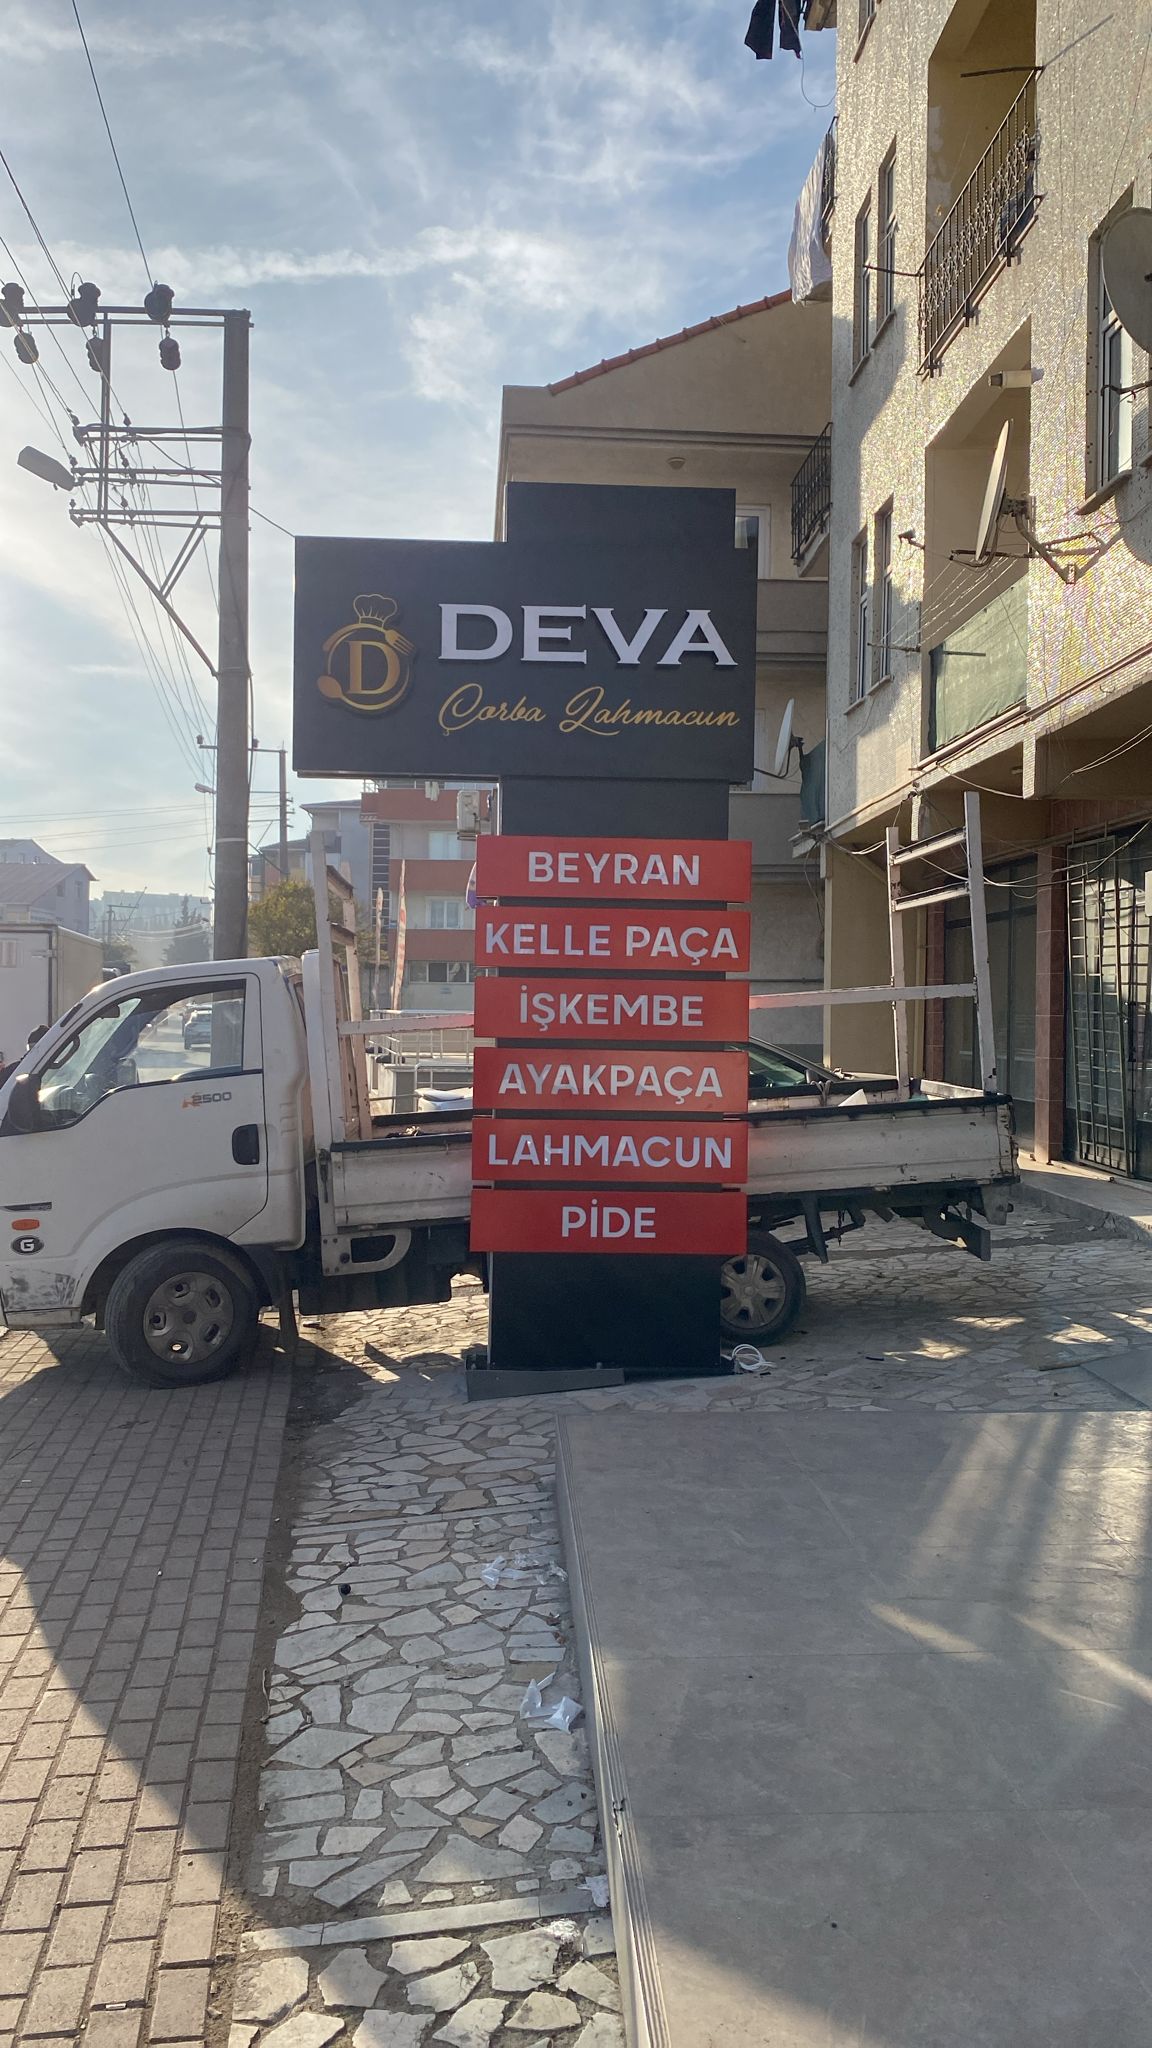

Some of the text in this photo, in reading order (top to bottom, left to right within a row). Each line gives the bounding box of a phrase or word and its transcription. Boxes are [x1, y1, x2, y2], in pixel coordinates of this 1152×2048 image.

[437, 603, 738, 666] DEVA
[347, 640, 400, 695] D
[438, 683, 741, 736] Çorba Lahmacun
[528, 851, 700, 886] BEYRAN
[486, 922, 739, 965] KELLE PAÇA
[520, 985, 704, 1031] İŞKEMBE
[498, 1063, 723, 1104] AYAKPAÇA
[488, 1134, 731, 1168] LAHMACUN
[561, 1199, 656, 1238] PİDE
[20, 1239, 35, 1252] G
